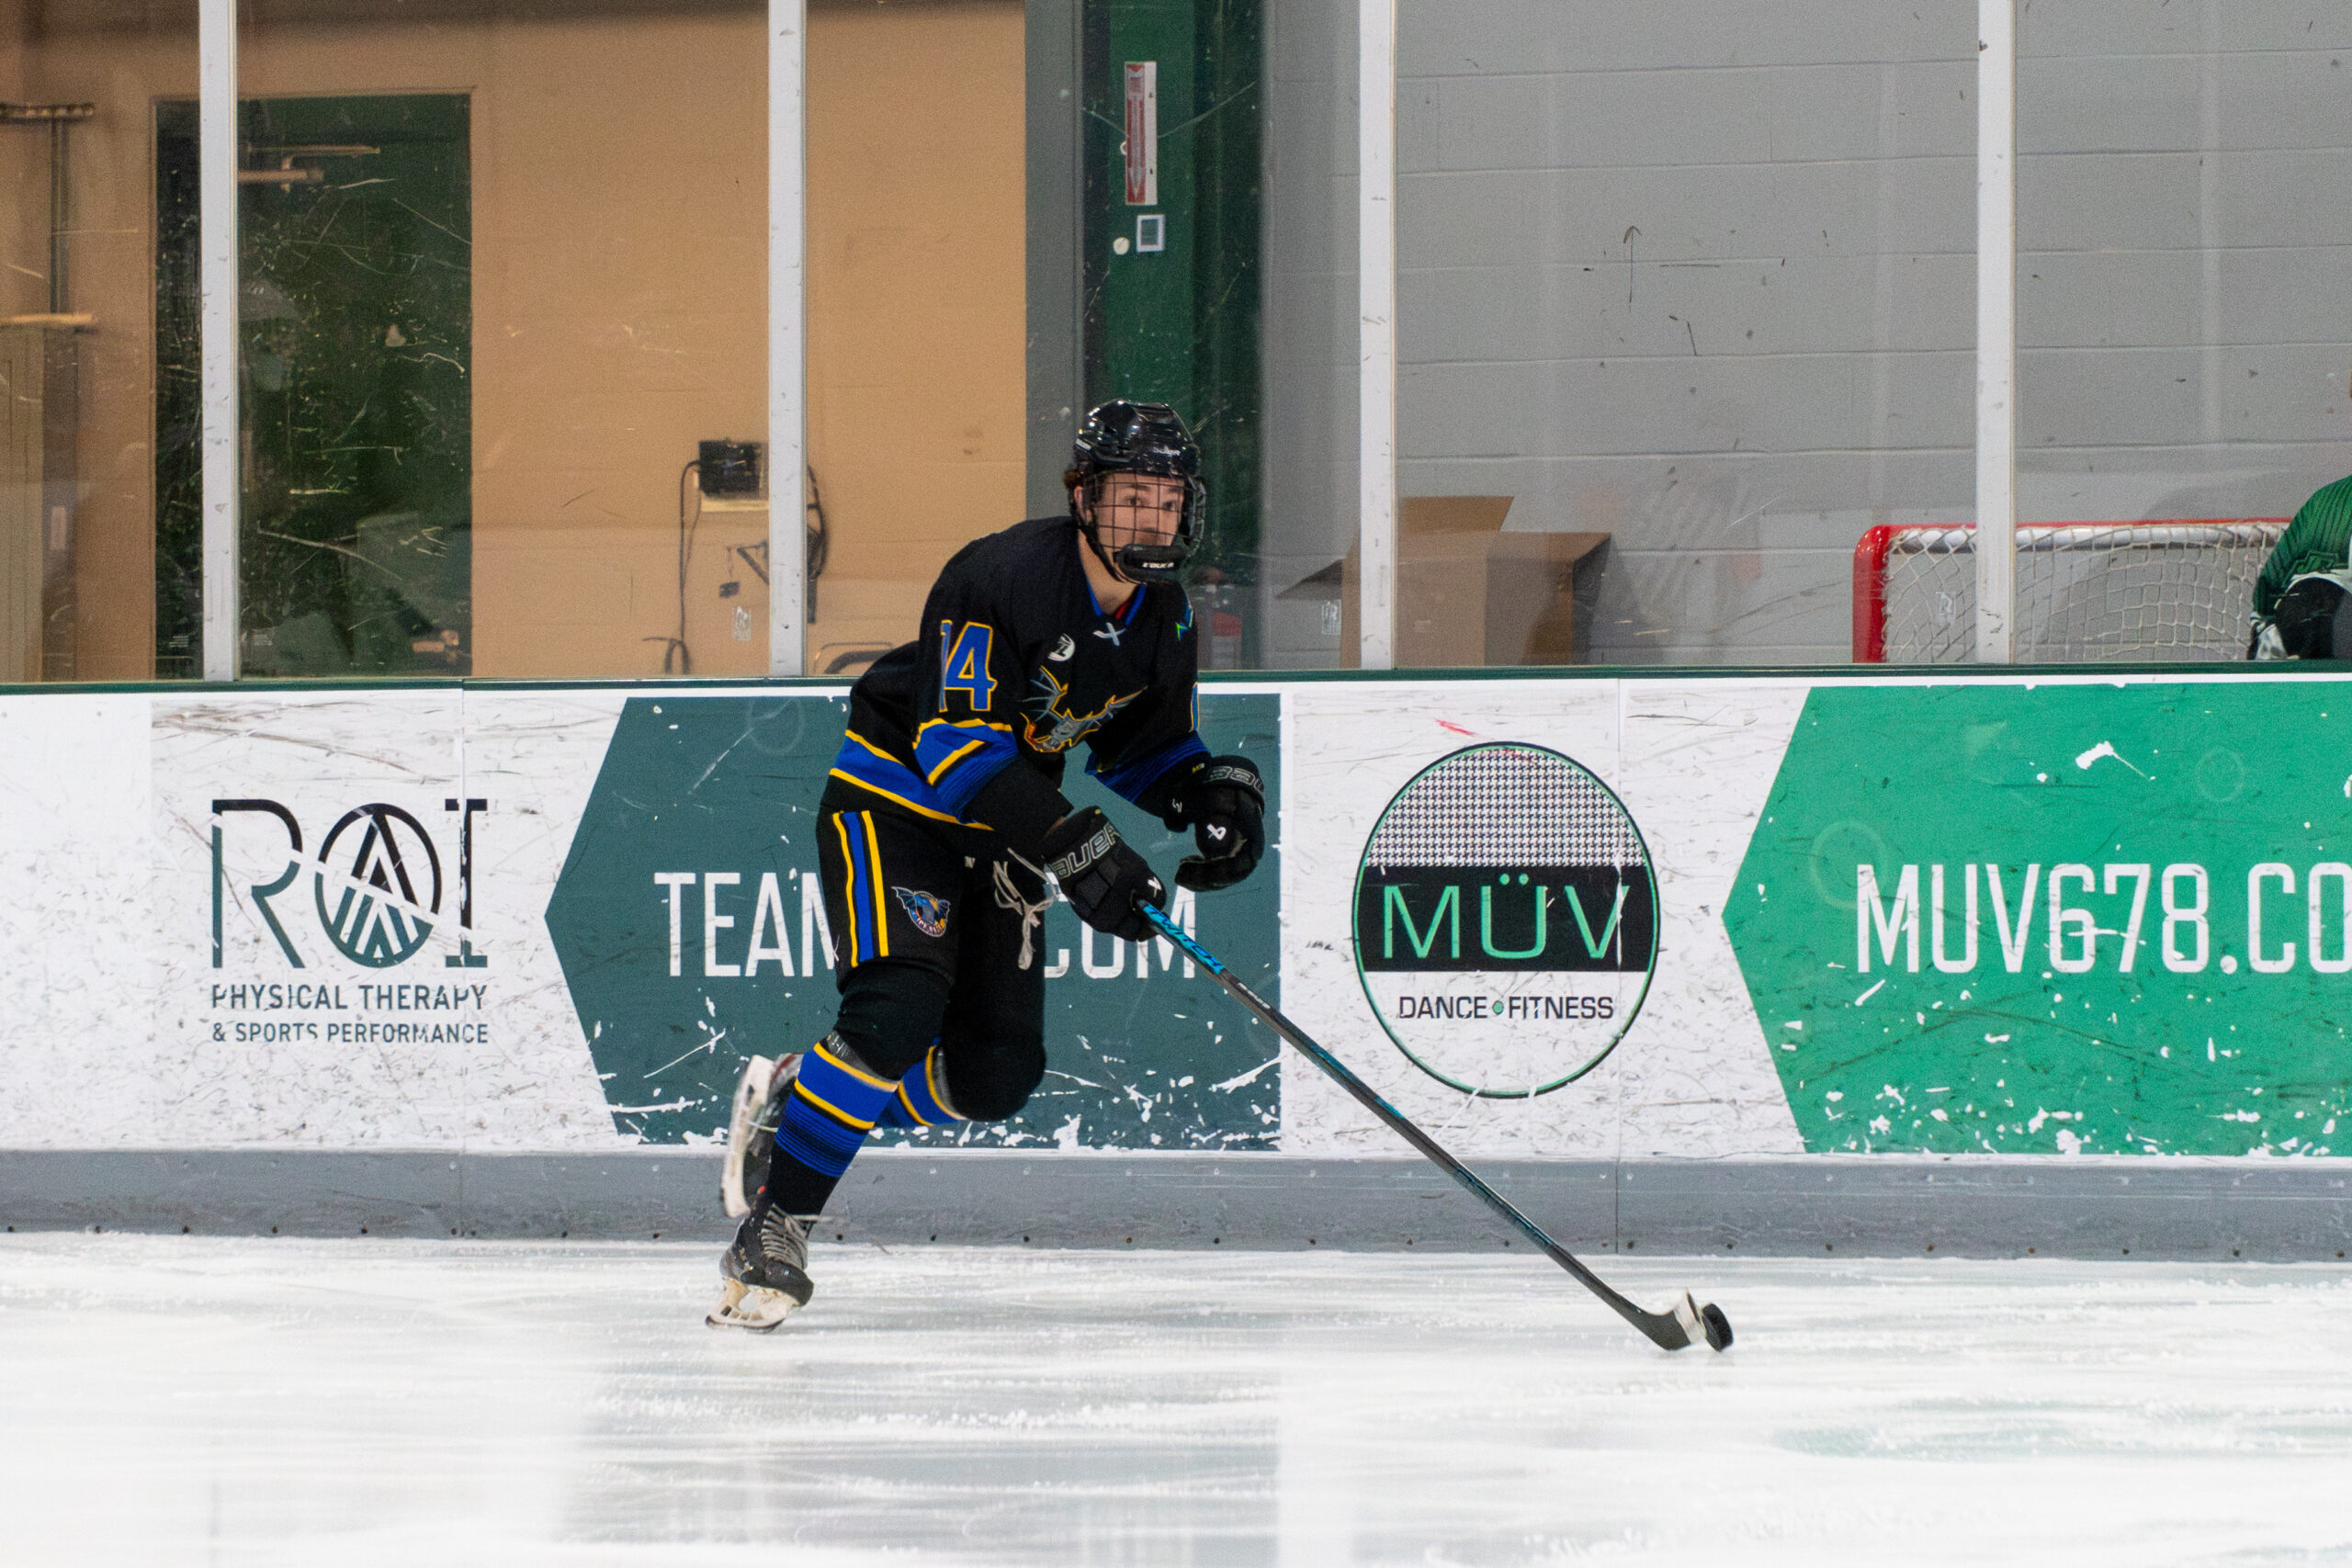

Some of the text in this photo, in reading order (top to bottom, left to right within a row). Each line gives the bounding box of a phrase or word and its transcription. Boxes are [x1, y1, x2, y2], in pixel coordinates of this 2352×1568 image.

[939, 619, 998, 713] 14
[212, 798, 488, 968] ROI
[1050, 820, 1121, 879] AUER
[1384, 873, 1630, 960] MÜV
[1857, 862, 2352, 974] MUV678.CO
[212, 984, 488, 1010] PHYSICAL THERAPY
[212, 1022, 488, 1043] & SPORTS PERFORMANCE
[1398, 996, 1614, 1020] DANCE FITNESS
